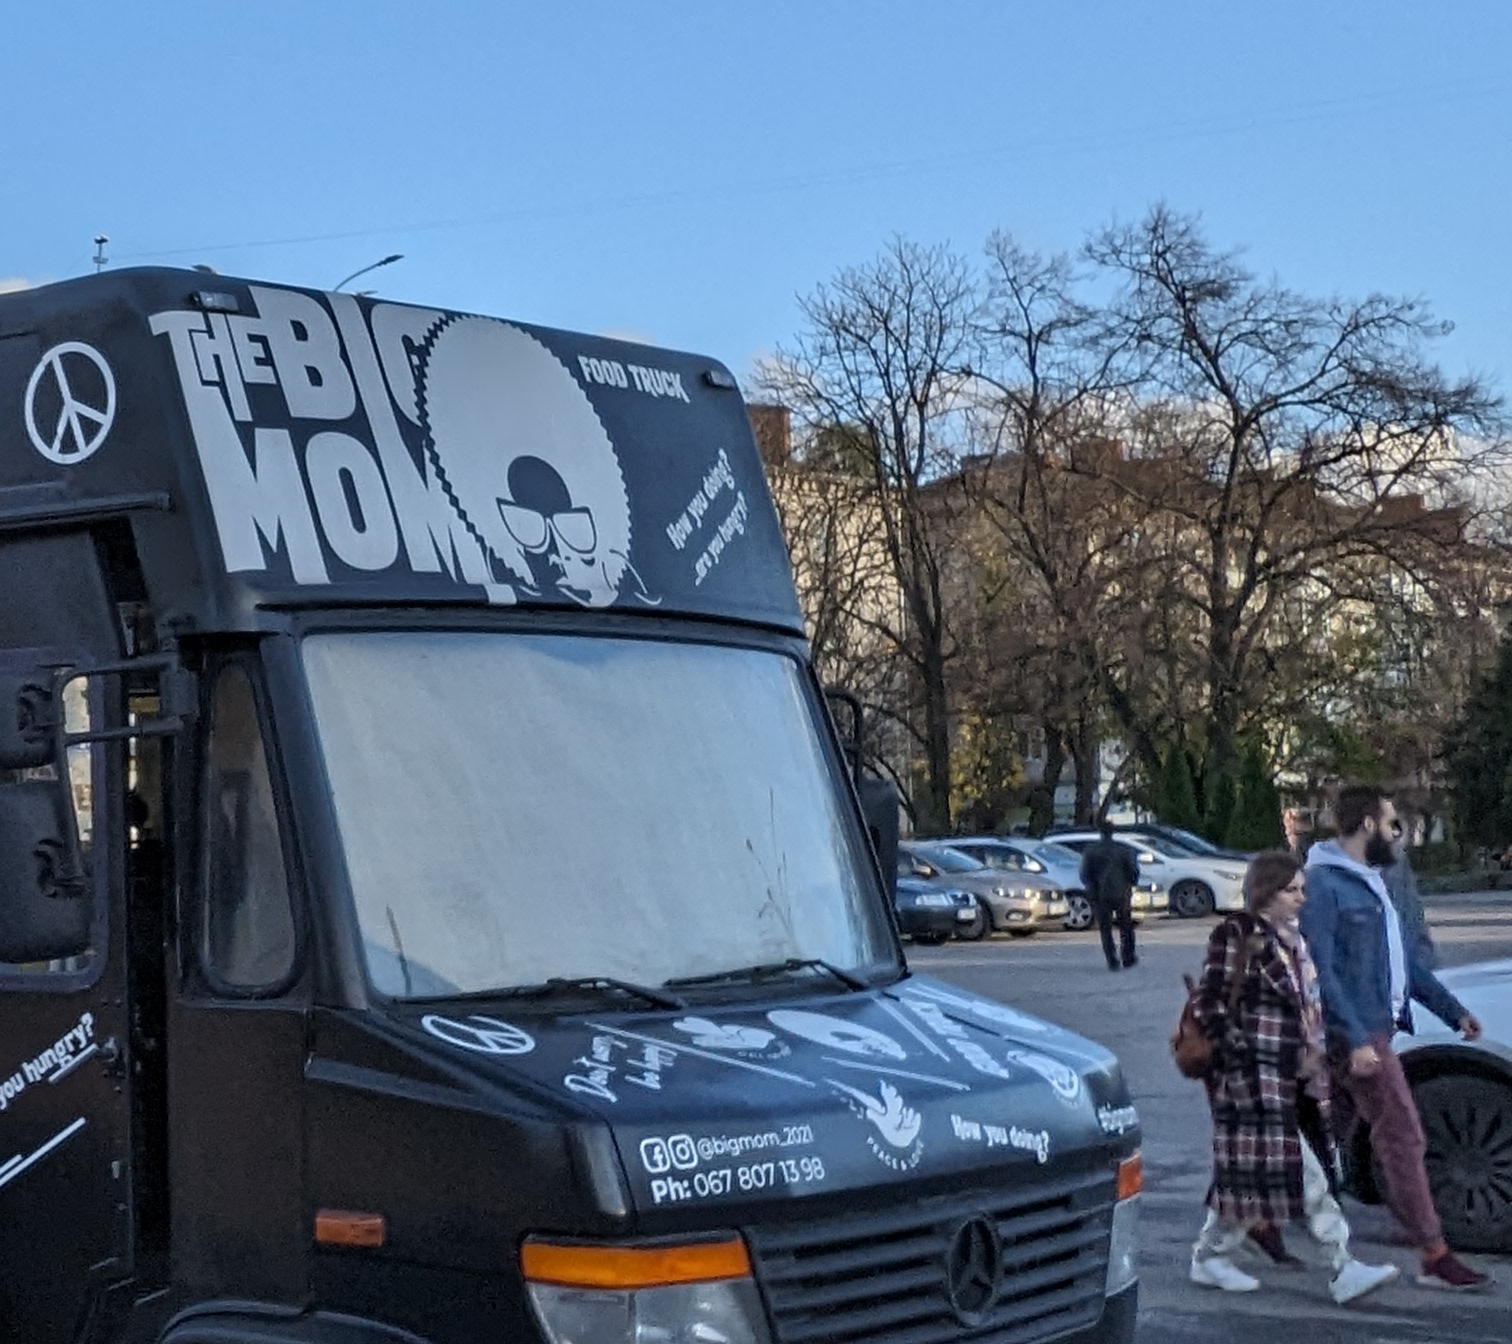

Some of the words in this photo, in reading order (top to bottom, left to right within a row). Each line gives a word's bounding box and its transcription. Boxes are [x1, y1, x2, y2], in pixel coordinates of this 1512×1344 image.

[148, 310, 277, 422] THE
[578, 355, 628, 388] FOOD
[627, 364, 690, 403] TRUCK
[188, 408, 517, 606] MOM
[666, 512, 693, 550] How
[687, 490, 708, 529] you
[703, 448, 735, 500] doing?
[708, 533, 724, 564] you
[718, 490, 747, 542] hungry?
[21, 1012, 94, 1083] hungry?
[697, 1124, 814, 1161] @bigmom_2021
[982, 1125, 1008, 1147] you
[651, 1176, 692, 1204] Ph:
[693, 1169, 732, 1197] 067
[737, 1162, 775, 1190] 807
[778, 1159, 800, 1183] 13
[800, 1157, 825, 1181] 98
